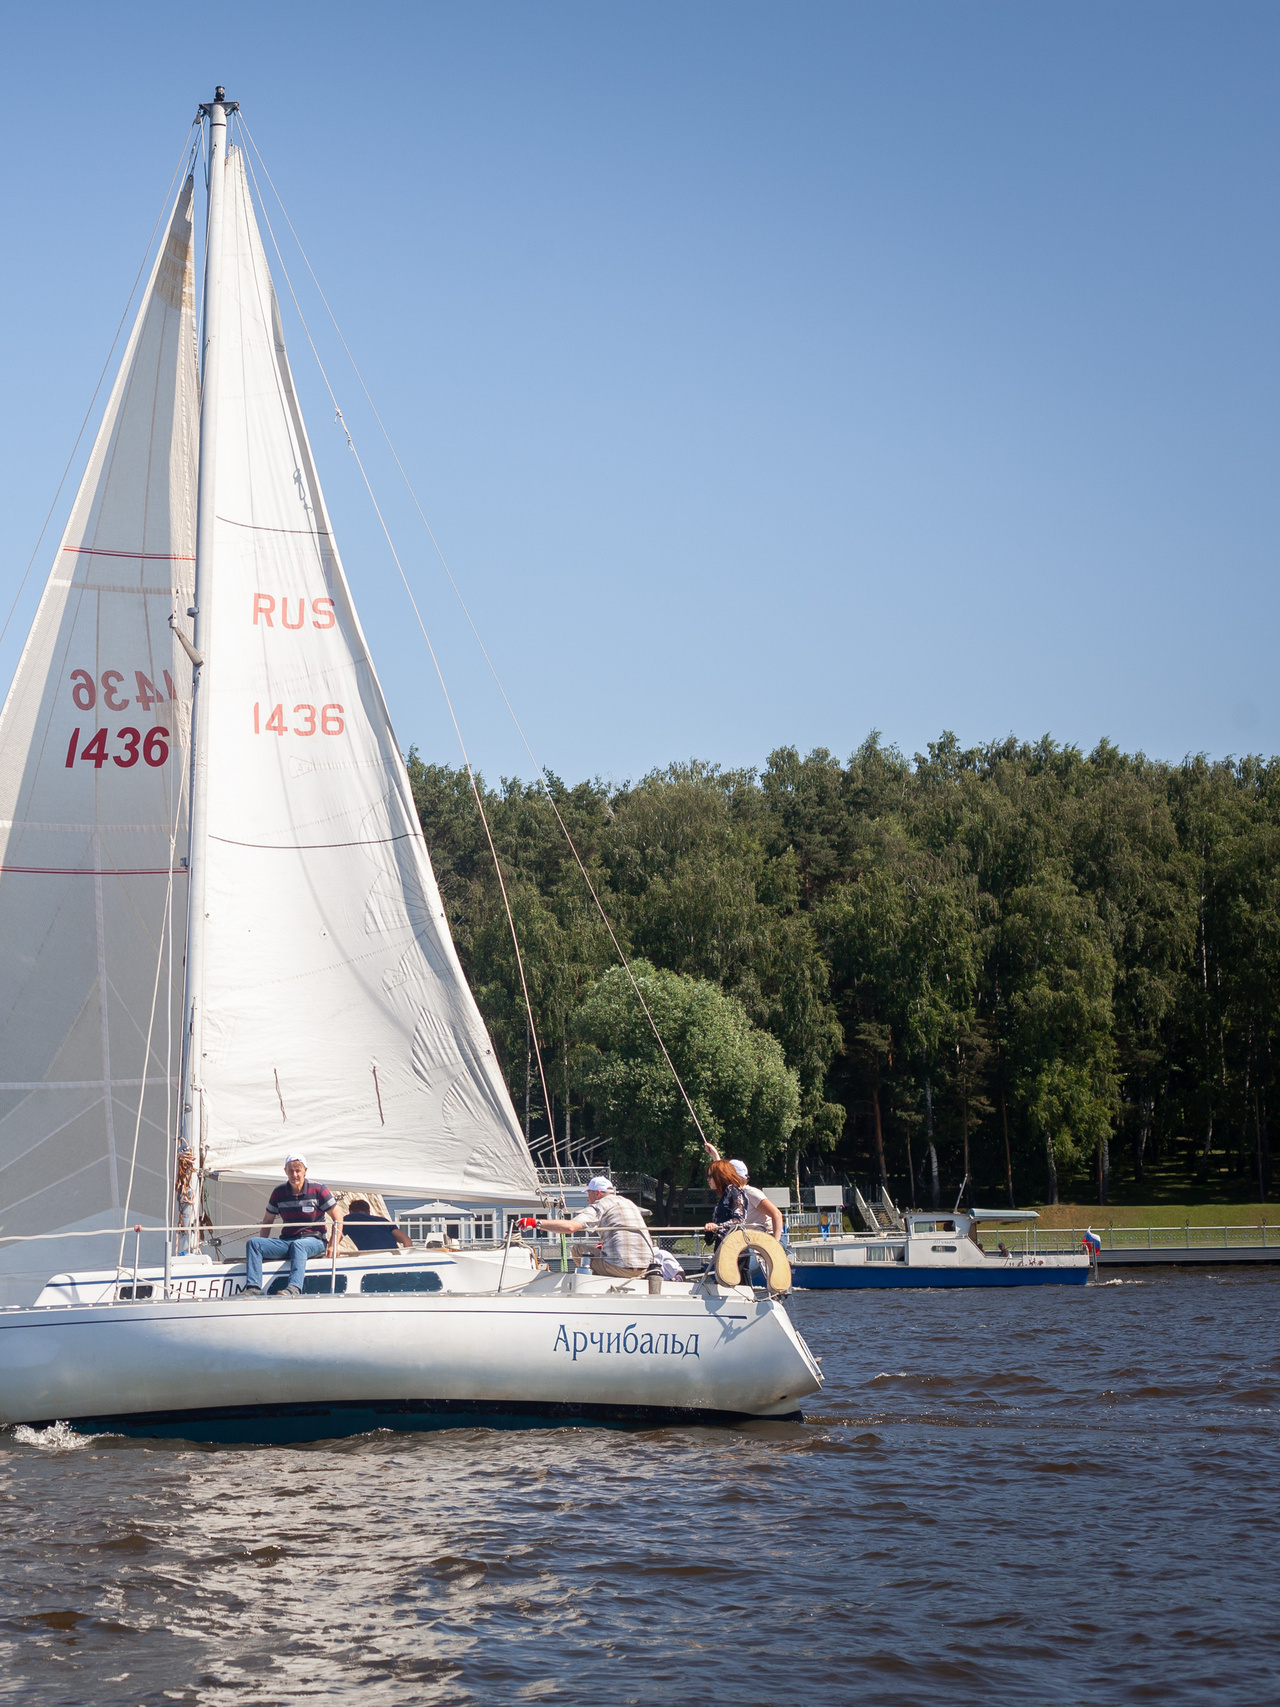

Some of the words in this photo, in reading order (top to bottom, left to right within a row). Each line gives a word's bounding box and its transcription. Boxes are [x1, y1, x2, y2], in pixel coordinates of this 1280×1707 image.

[253, 592, 336, 630] RUS
[254, 702, 345, 737] 1436
[65, 726, 170, 769] 1436
[553, 1322, 701, 1361] Арчибальд
